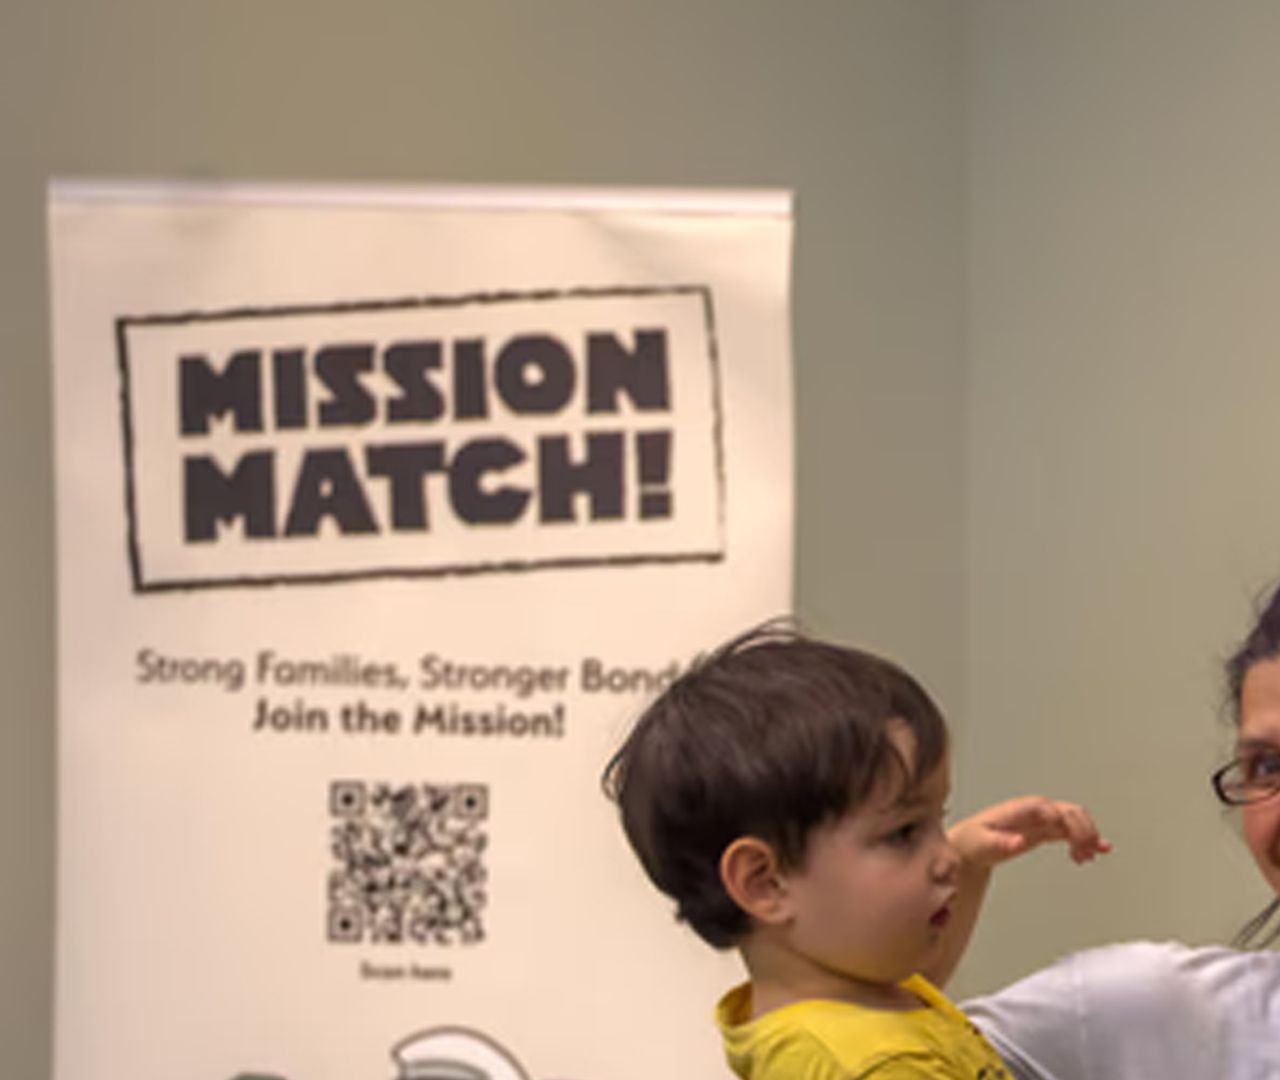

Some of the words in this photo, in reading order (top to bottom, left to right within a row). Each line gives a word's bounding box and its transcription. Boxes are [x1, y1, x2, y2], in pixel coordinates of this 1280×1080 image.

[178, 328, 671, 434] MISSION
[182, 429, 674, 545] MATCH!
[135, 648, 246, 693] Strong
[256, 649, 409, 690] Families,
[420, 653, 569, 698] Stronger
[253, 698, 330, 732] Join
[340, 702, 400, 735] the
[413, 703, 566, 738] Mission!
